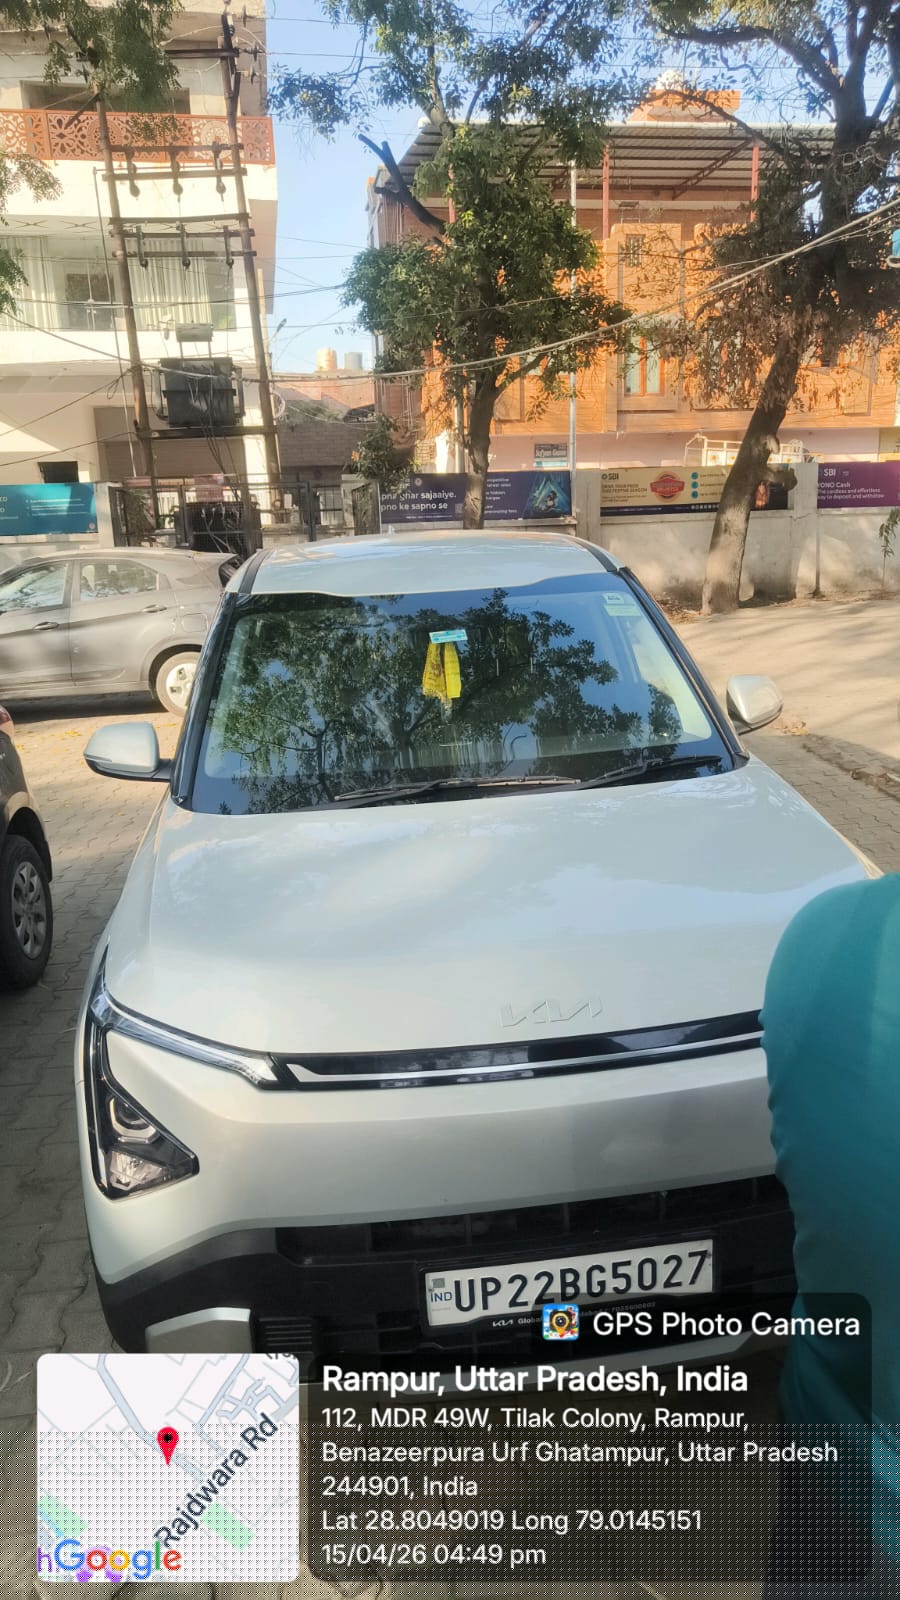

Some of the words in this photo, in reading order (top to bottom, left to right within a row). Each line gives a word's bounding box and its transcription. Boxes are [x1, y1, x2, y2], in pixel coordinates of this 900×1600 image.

[823, 468, 837, 477] SBI
[381, 493, 397, 501] pna
[421, 490, 457, 501] sajaaiye.
[380, 504, 398, 513] pno
[399, 502, 410, 510] ke
[411, 503, 437, 511] sapno
[454, 1250, 709, 1313] UP22BG5027
[430, 1291, 453, 1303] IND
